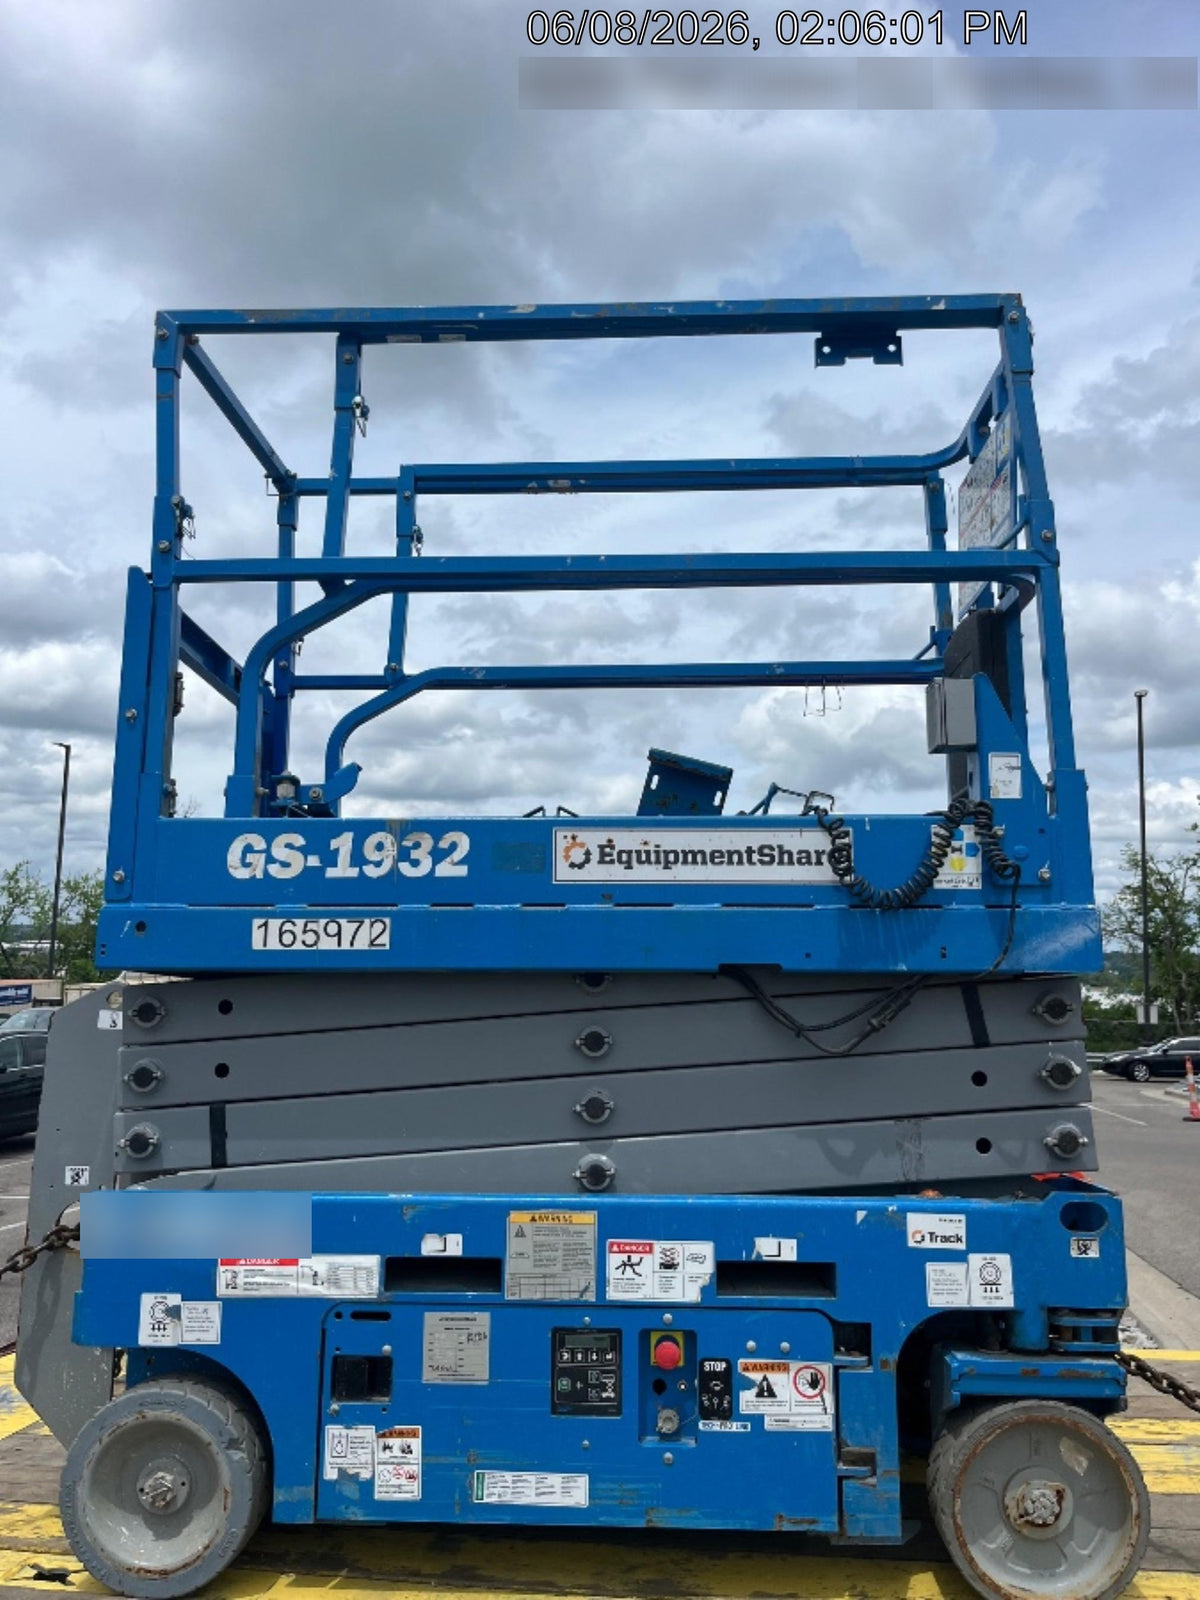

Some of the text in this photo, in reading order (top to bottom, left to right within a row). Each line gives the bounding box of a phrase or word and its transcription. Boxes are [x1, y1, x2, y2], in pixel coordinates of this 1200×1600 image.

[226, 831, 471, 880] GS-1932
[256, 918, 388, 948] 165972
[928, 1231, 963, 1244] Track
[703, 1361, 727, 1372] STOP
[750, 1362, 788, 1373] WARNING
